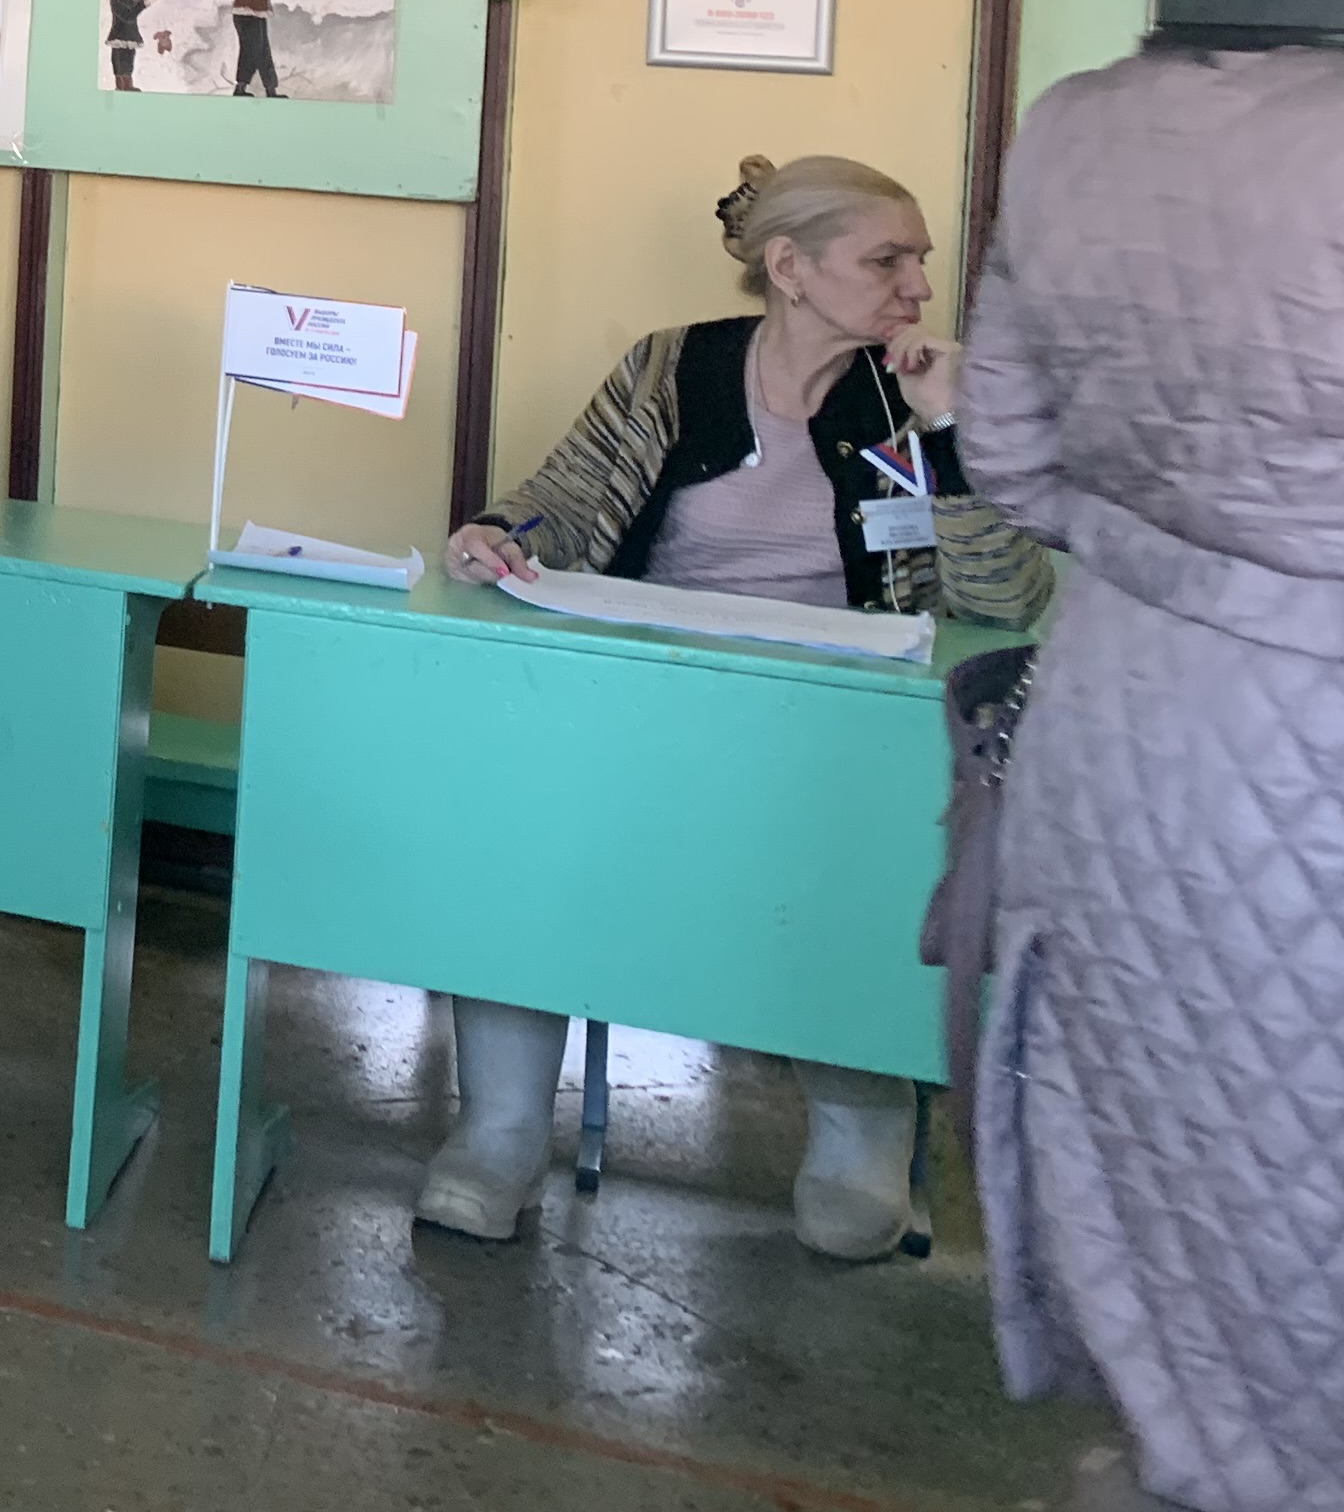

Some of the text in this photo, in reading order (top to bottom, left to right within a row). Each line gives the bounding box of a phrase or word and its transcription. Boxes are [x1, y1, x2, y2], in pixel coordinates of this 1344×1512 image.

[274, 336, 304, 349] ВМЕСТЕ
[306, 340, 320, 350] МЫ
[266, 346, 306, 359] ГОЛОСУЕМ
[308, 352, 318, 361] ЗА
